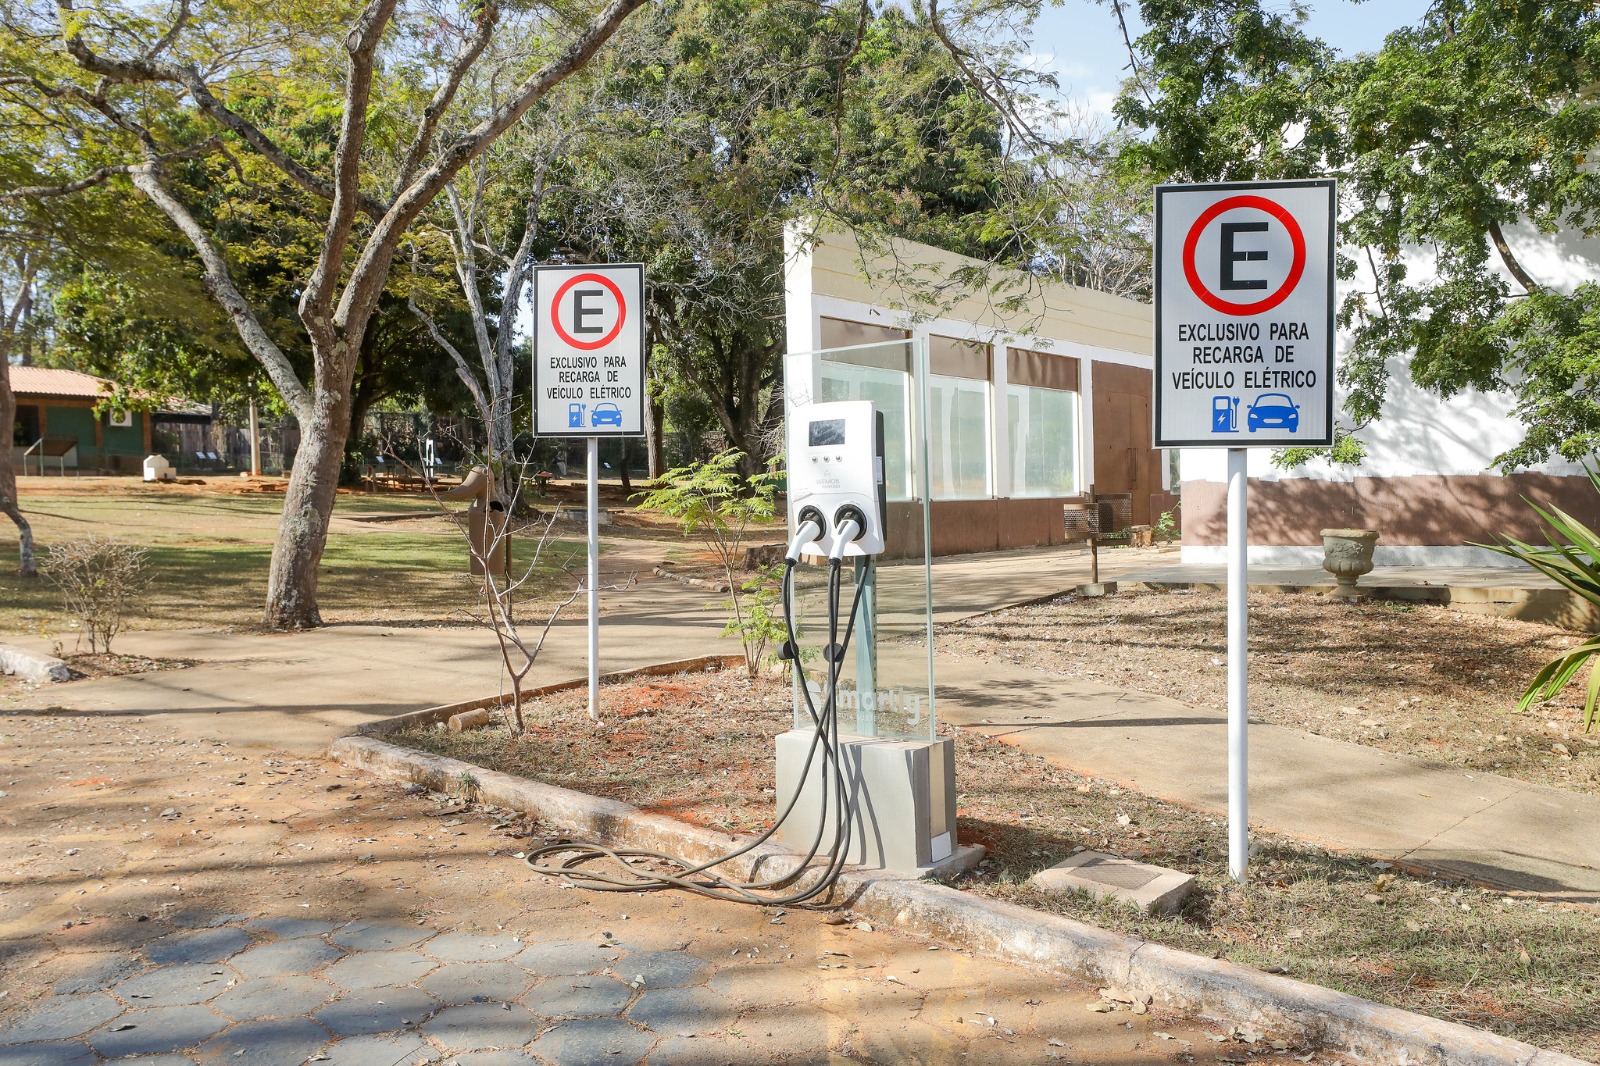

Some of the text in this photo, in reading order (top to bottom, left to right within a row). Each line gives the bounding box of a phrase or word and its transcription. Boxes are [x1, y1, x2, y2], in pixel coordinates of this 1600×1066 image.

[1220, 222, 1269, 290] E
[574, 290, 603, 333] E
[1178, 322, 1309, 342] EXCLUSIVO PARA
[550, 356, 627, 368] EXCLUSIVO PARA
[1192, 345, 1294, 364] RECARGA DE
[559, 371, 618, 383] RECARGA DE
[1172, 367, 1317, 389] VEÍCULO ELÉTRICO
[547, 385, 631, 399] VEÍCULO ELÉTRICO
[823, 680, 921, 726] martly
